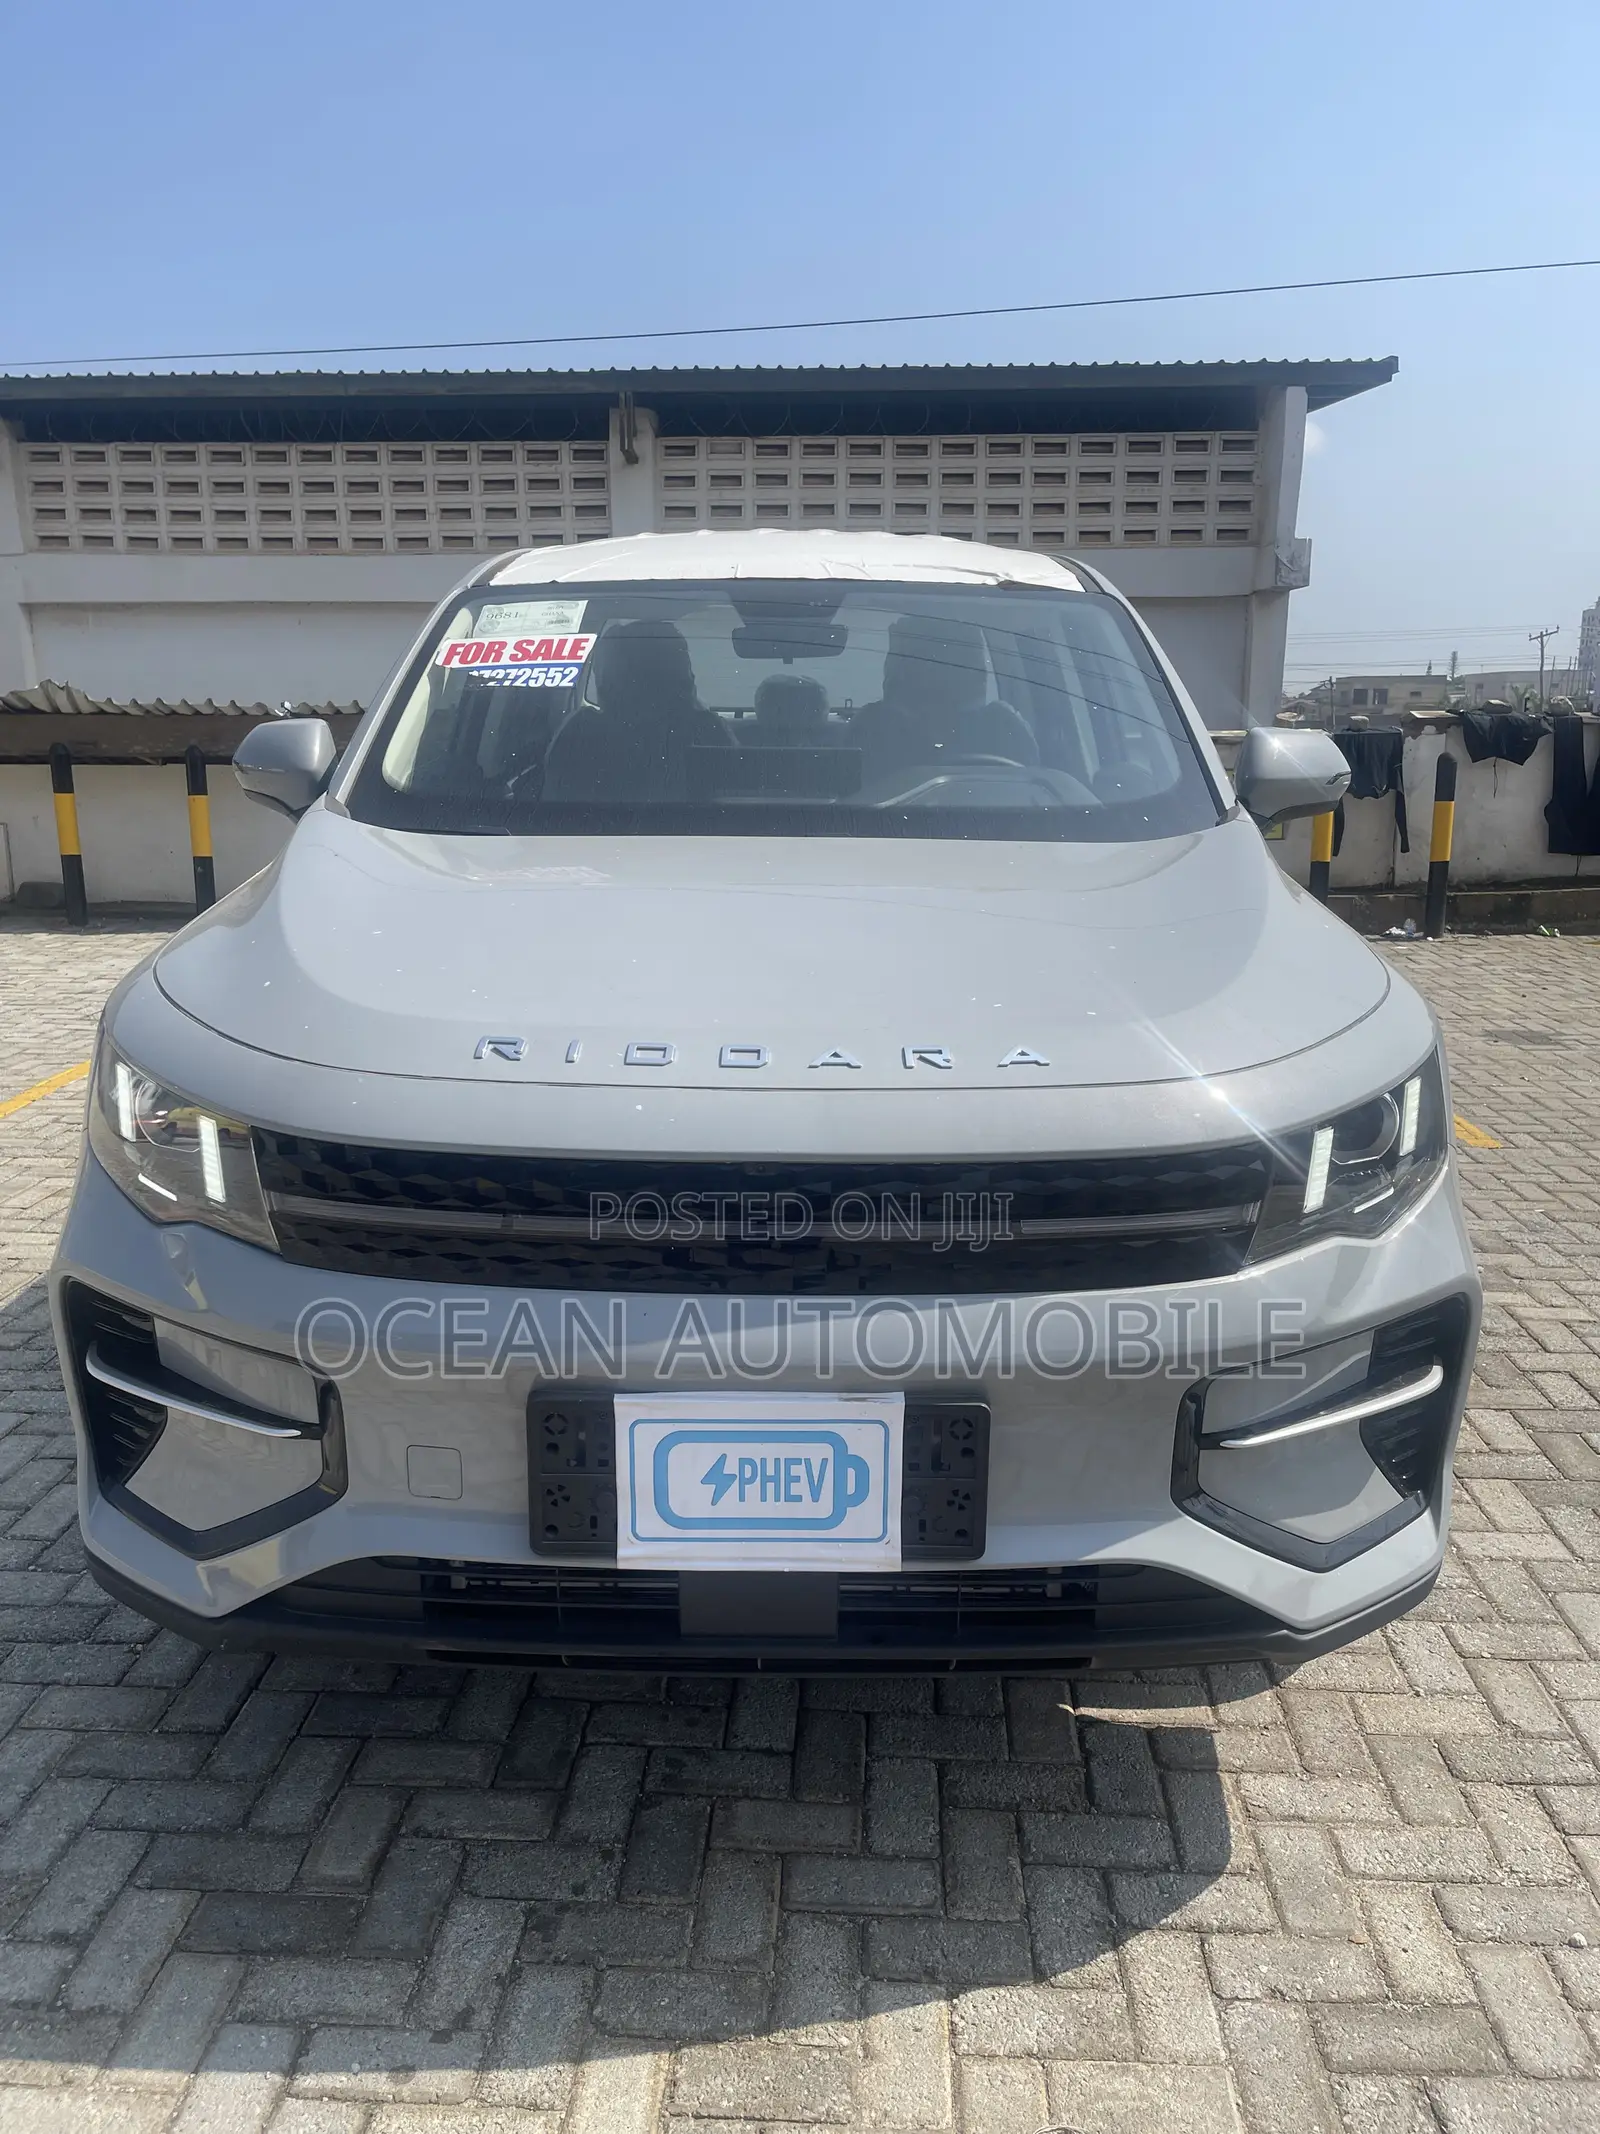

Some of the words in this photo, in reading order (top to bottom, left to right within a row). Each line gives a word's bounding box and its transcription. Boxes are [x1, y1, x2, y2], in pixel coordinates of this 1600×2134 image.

[442, 641, 507, 666] FOR
[508, 638, 589, 663] SALE
[473, 1035, 1051, 1070] RIDDARA
[738, 1457, 829, 1503] PHEV
